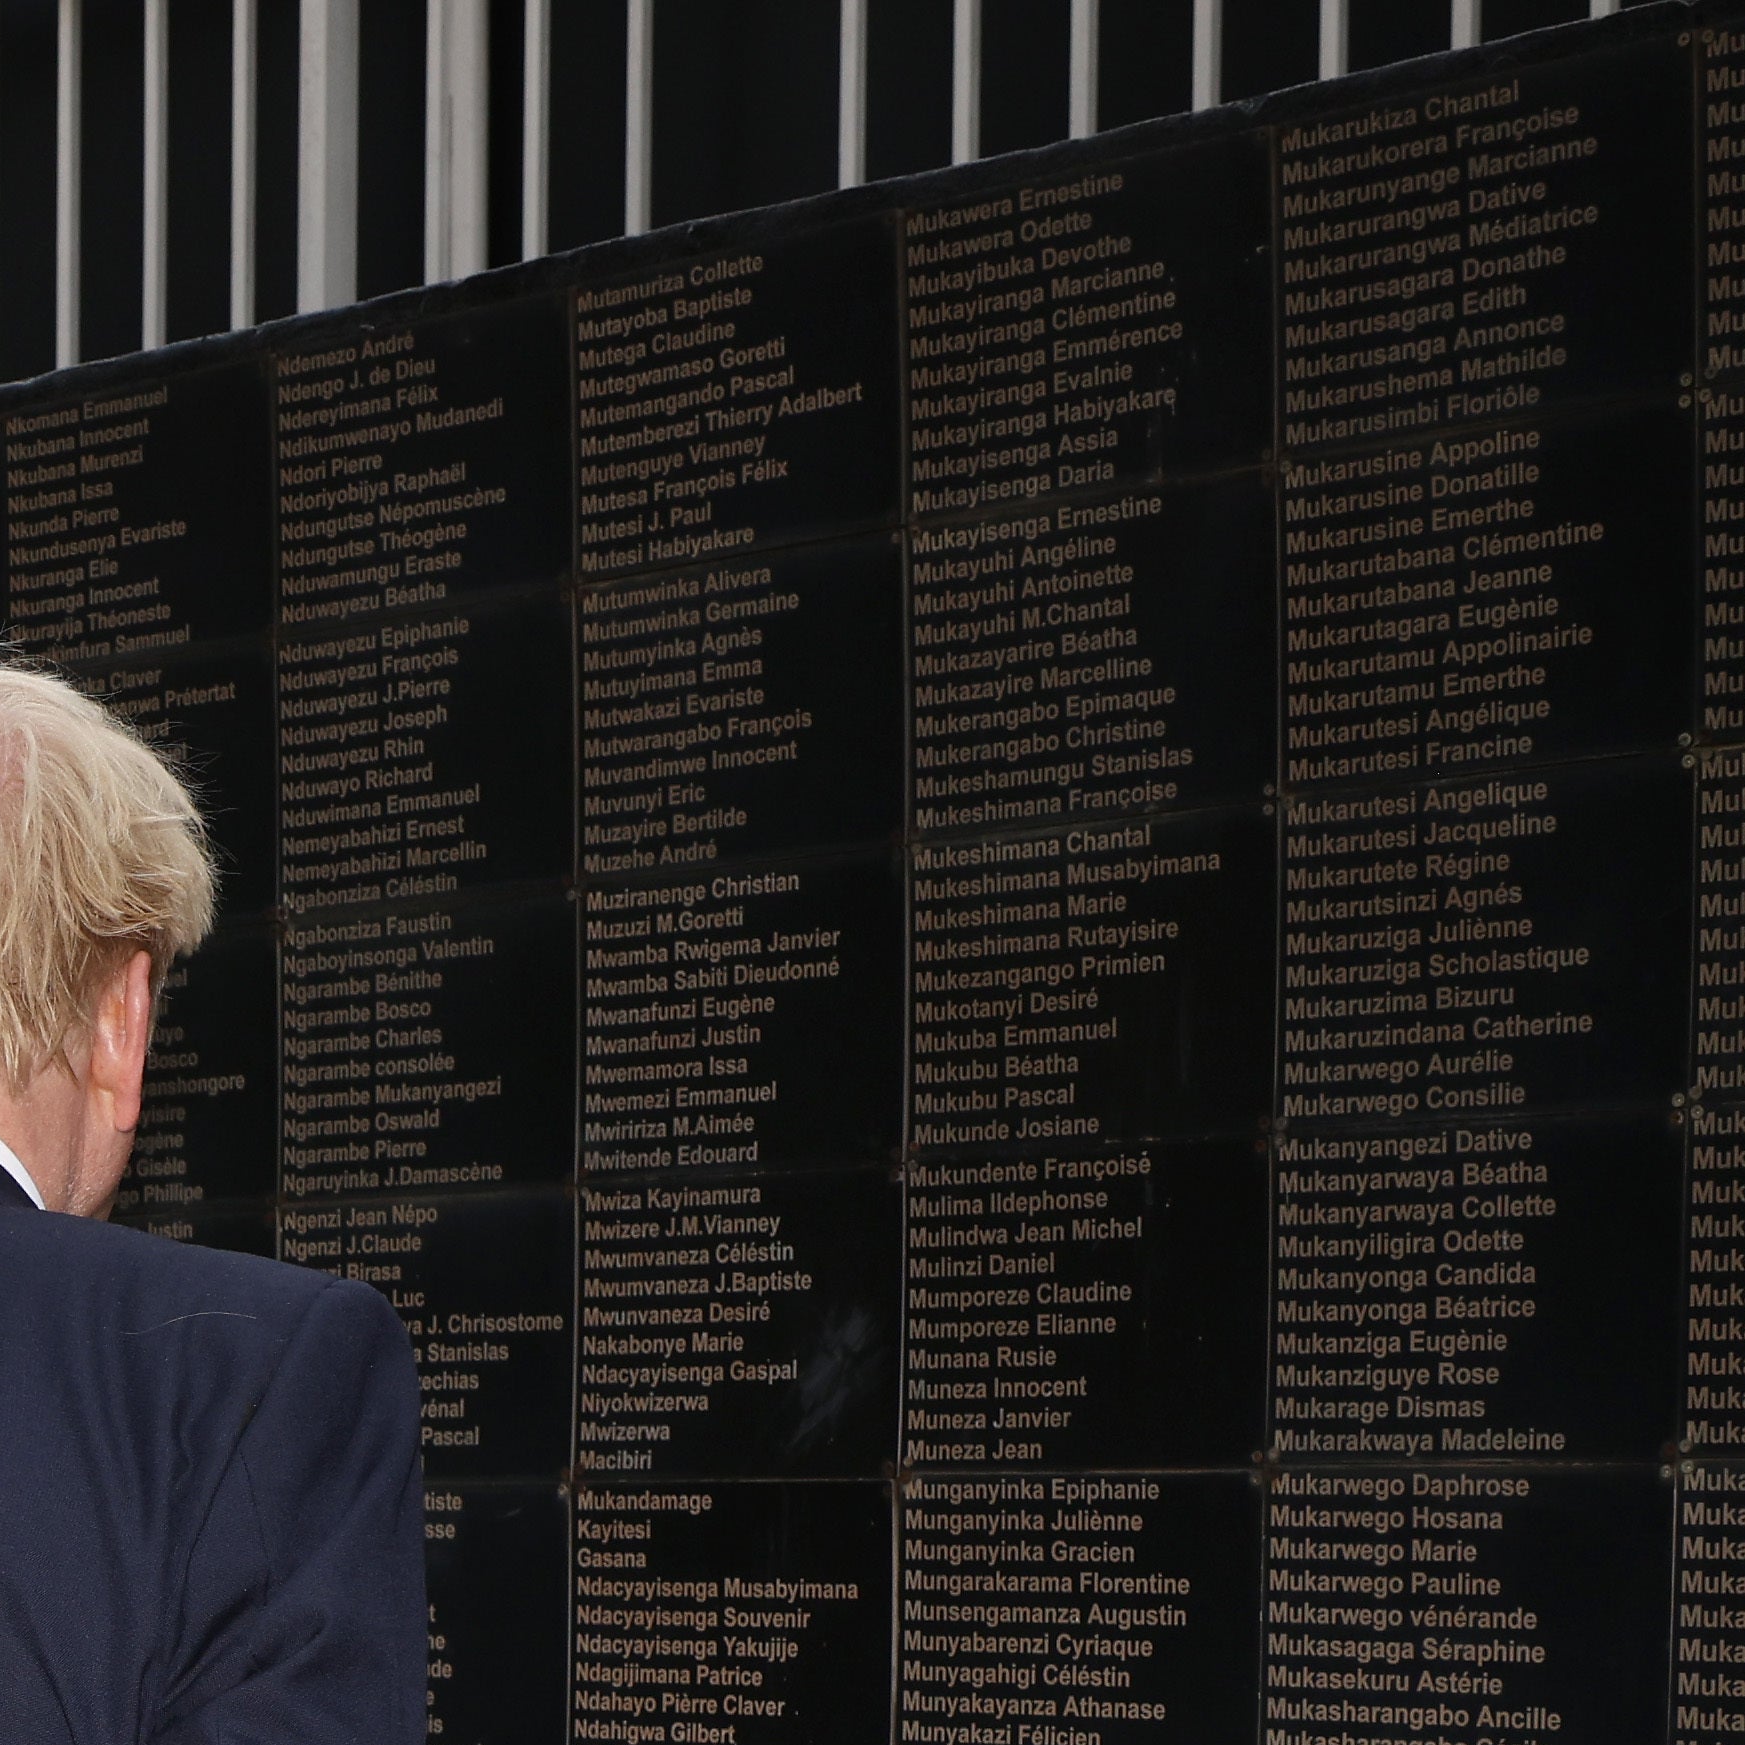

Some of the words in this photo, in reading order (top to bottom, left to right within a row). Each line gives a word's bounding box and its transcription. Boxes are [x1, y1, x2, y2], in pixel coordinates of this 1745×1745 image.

[1284, 233, 1461, 284] Mukarurangwa
[1469, 205, 1599, 247] Médiatrice
[1287, 545, 1455, 587] Mukarutabana
[1462, 521, 1604, 560] Clémentine
[915, 701, 1060, 738] Mukerangabo
[1066, 686, 1176, 721] Epimaque
[587, 884, 706, 912] Muziranenge
[711, 872, 800, 899] Christian
[914, 870, 1061, 902] Mukeshimana
[1067, 853, 1221, 885] Musabyimana
[284, 919, 382, 951] Ngabonziza
[386, 911, 452, 936] Faustin
[586, 973, 668, 999] Mwamba
[674, 966, 728, 990] Sabiti
[734, 955, 840, 985] Dieudonné
[1286, 958, 1421, 988] Mukaruziga
[1428, 945, 1590, 977] Scholastique
[586, 998, 696, 1027] Mwanafunzi
[702, 993, 776, 1020] Eugène
[1285, 1021, 1465, 1053] Mukaruzindana
[1473, 1011, 1593, 1040] Catherine
[283, 1086, 371, 1115] Ngarambe
[375, 1074, 502, 1105] Mukanyangezi
[585, 1088, 670, 1114] Mwemezi
[676, 1080, 777, 1108] Emmanuel
[1278, 1202, 1454, 1229] Mukanyarwaya
[1461, 1194, 1557, 1219] Collette
[909, 1224, 1008, 1248] Mulindwa
[1014, 1221, 1065, 1244] Jean
[1072, 1215, 1142, 1241] Michel
[583, 1334, 687, 1359] Nakabonye
[692, 1331, 744, 1352] Marie
[1270, 1504, 1405, 1534] Mukarwego
[1412, 1506, 1503, 1530] Hosana
[577, 1576, 718, 1603] Ndacyayisenga
[724, 1577, 859, 1604] Musabyimana
[905, 1569, 1073, 1597] Mungarakarama
[1079, 1571, 1191, 1595] Florentine
[904, 1629, 1049, 1658] Munyabarenzi
[1056, 1633, 1154, 1662] Cyriaque
[575, 1690, 657, 1717] Ndahayo
[723, 1694, 786, 1717] Claver
